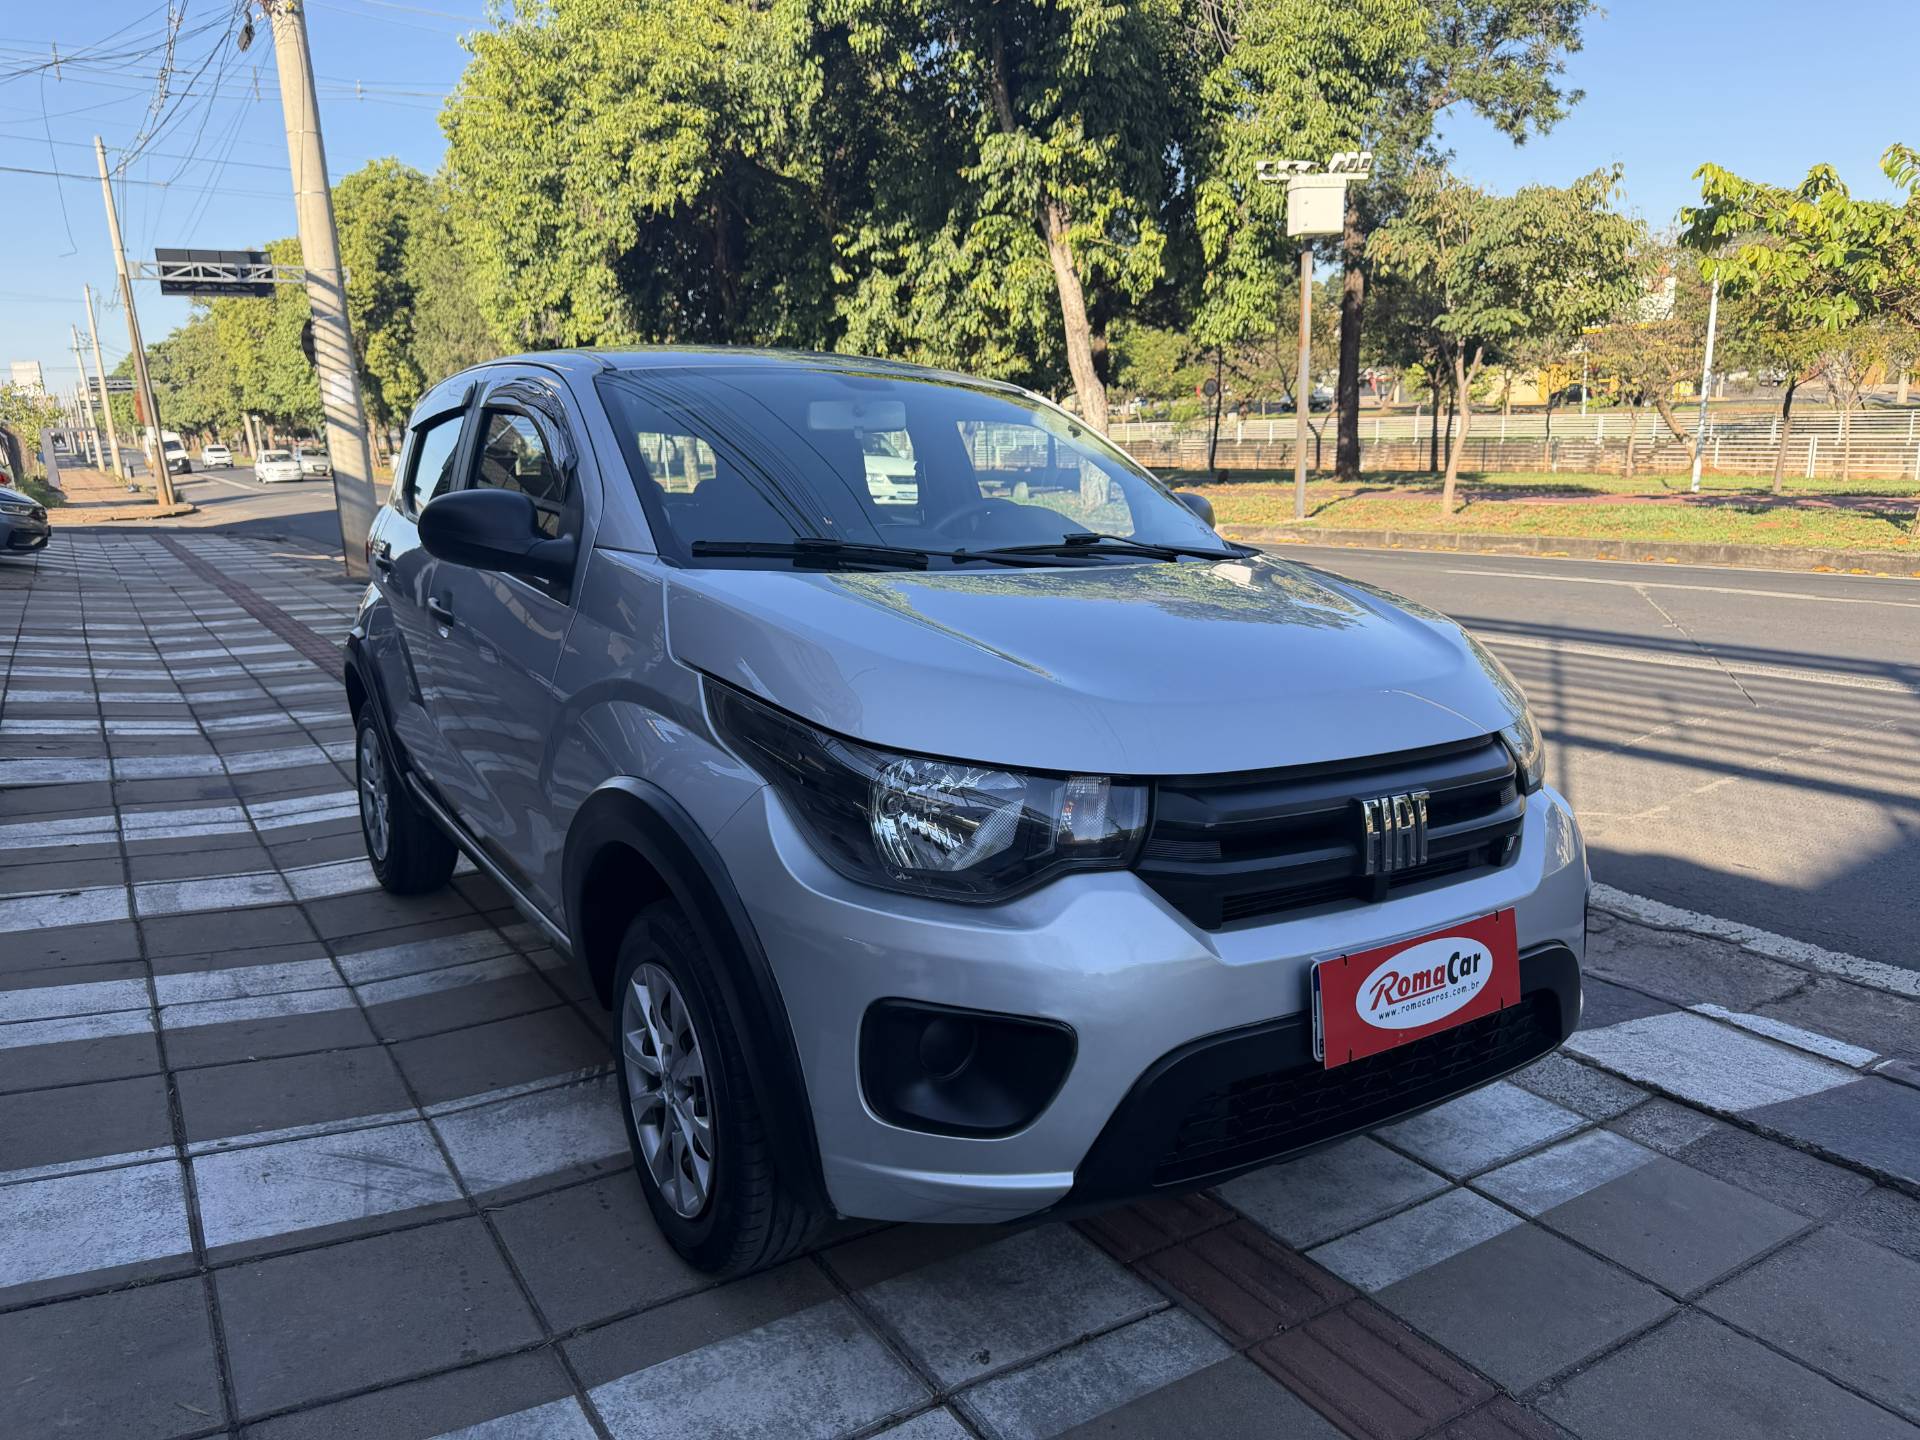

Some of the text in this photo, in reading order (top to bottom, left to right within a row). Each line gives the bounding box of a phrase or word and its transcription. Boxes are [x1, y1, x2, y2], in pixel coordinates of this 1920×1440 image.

[1362, 790, 1431, 875] FIAT
[1369, 951, 1481, 1011] RomaCar
[1378, 980, 1480, 1020] www.romacarros.com.br
